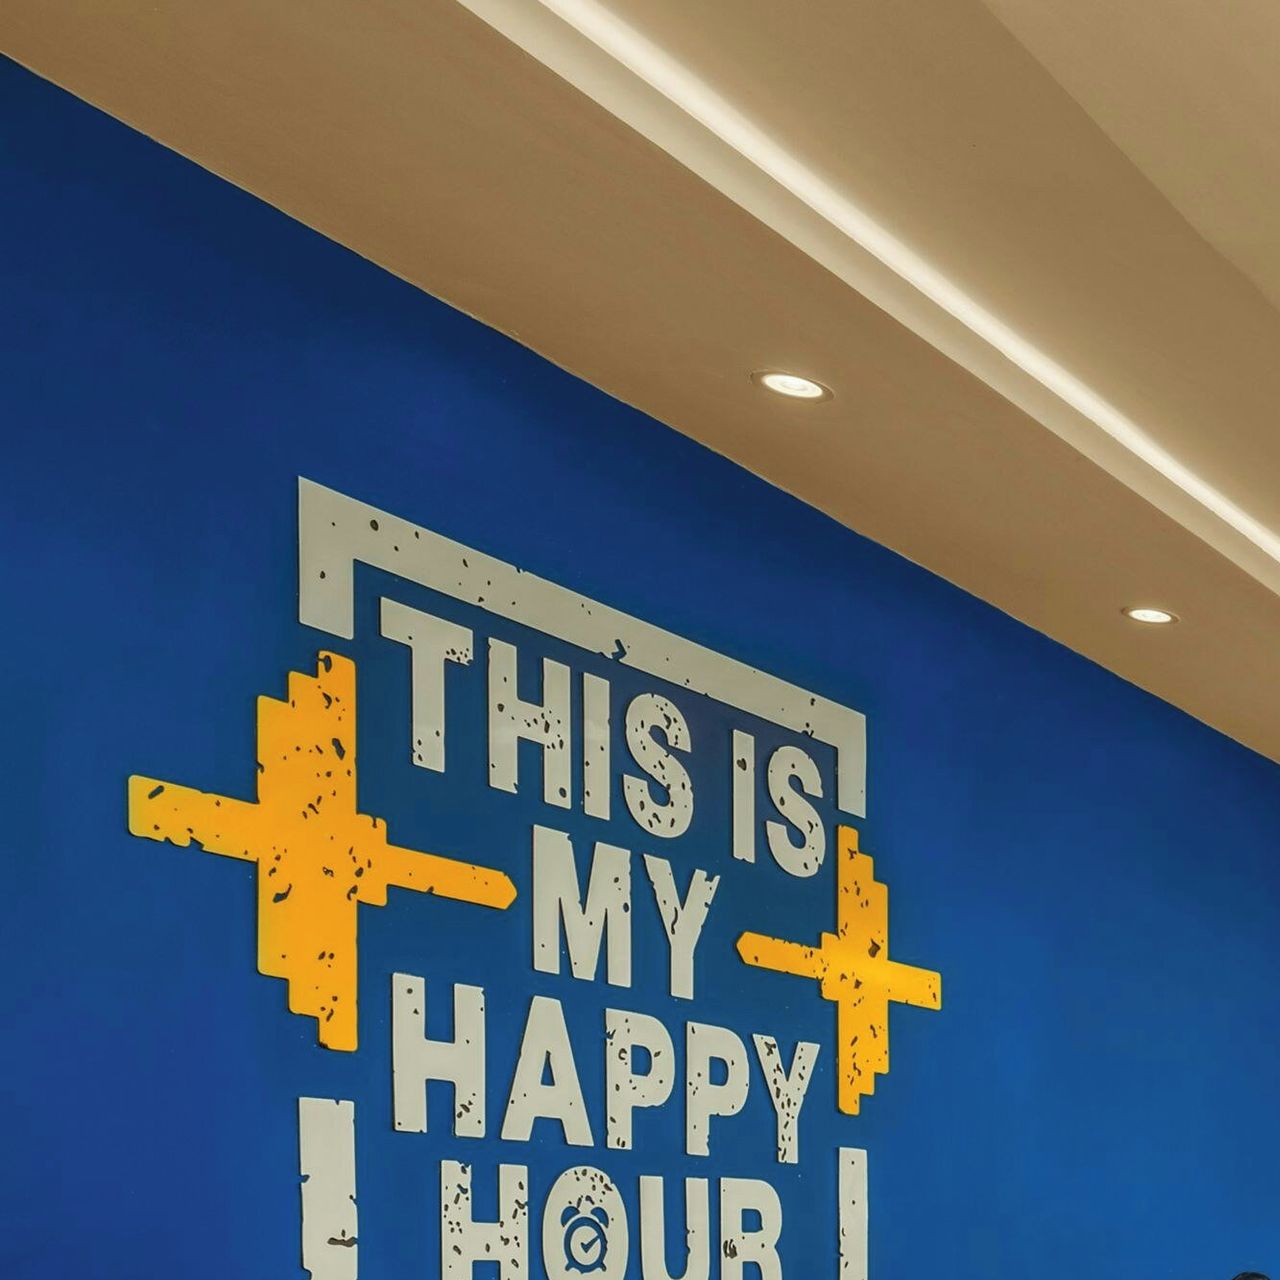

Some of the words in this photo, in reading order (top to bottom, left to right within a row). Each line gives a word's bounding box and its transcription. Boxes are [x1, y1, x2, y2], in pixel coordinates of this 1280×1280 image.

[380, 596, 695, 840] THIS
[731, 727, 828, 879] IS
[532, 824, 722, 1001] MY
[391, 972, 821, 1164] HAPPY
